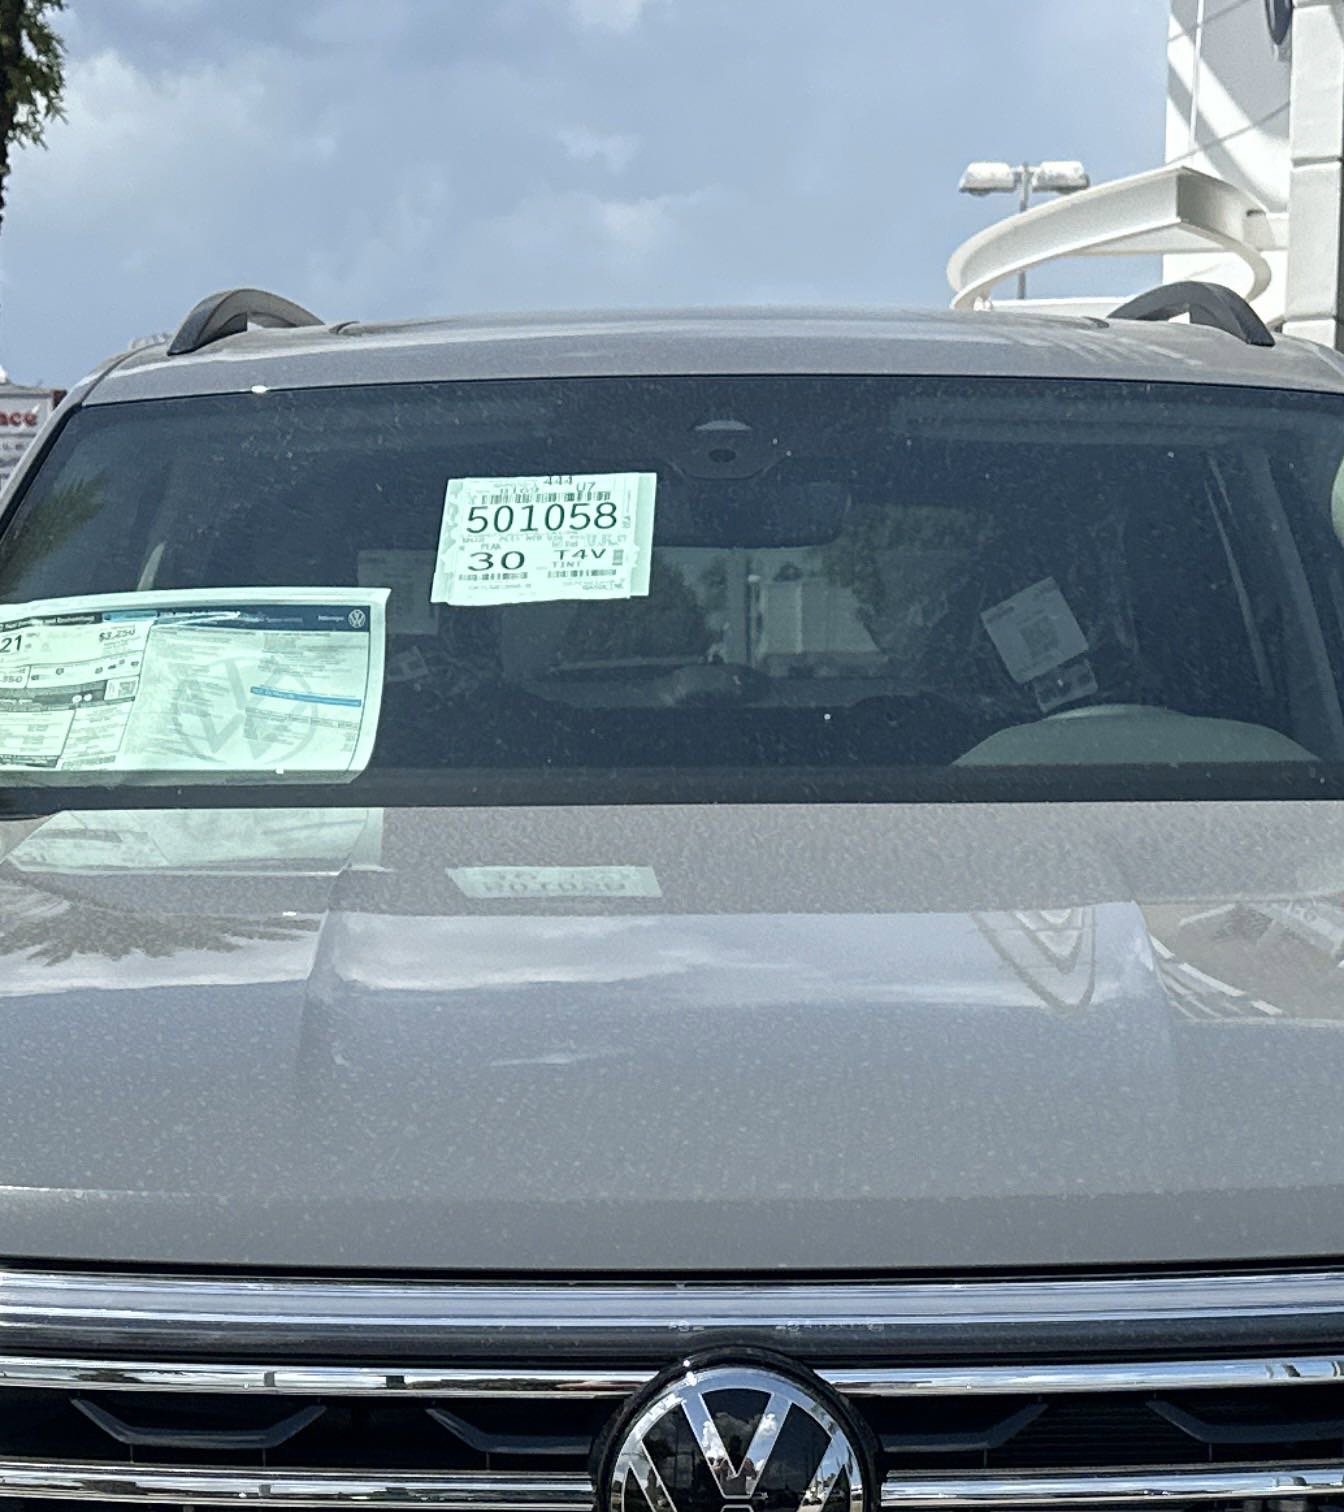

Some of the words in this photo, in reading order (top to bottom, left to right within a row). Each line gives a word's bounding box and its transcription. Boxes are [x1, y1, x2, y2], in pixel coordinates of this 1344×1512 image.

[466, 502, 617, 533] 501058
[467, 551, 525, 571] 30
[553, 548, 606, 560] T4V
[0, 635, 22, 653] 21
